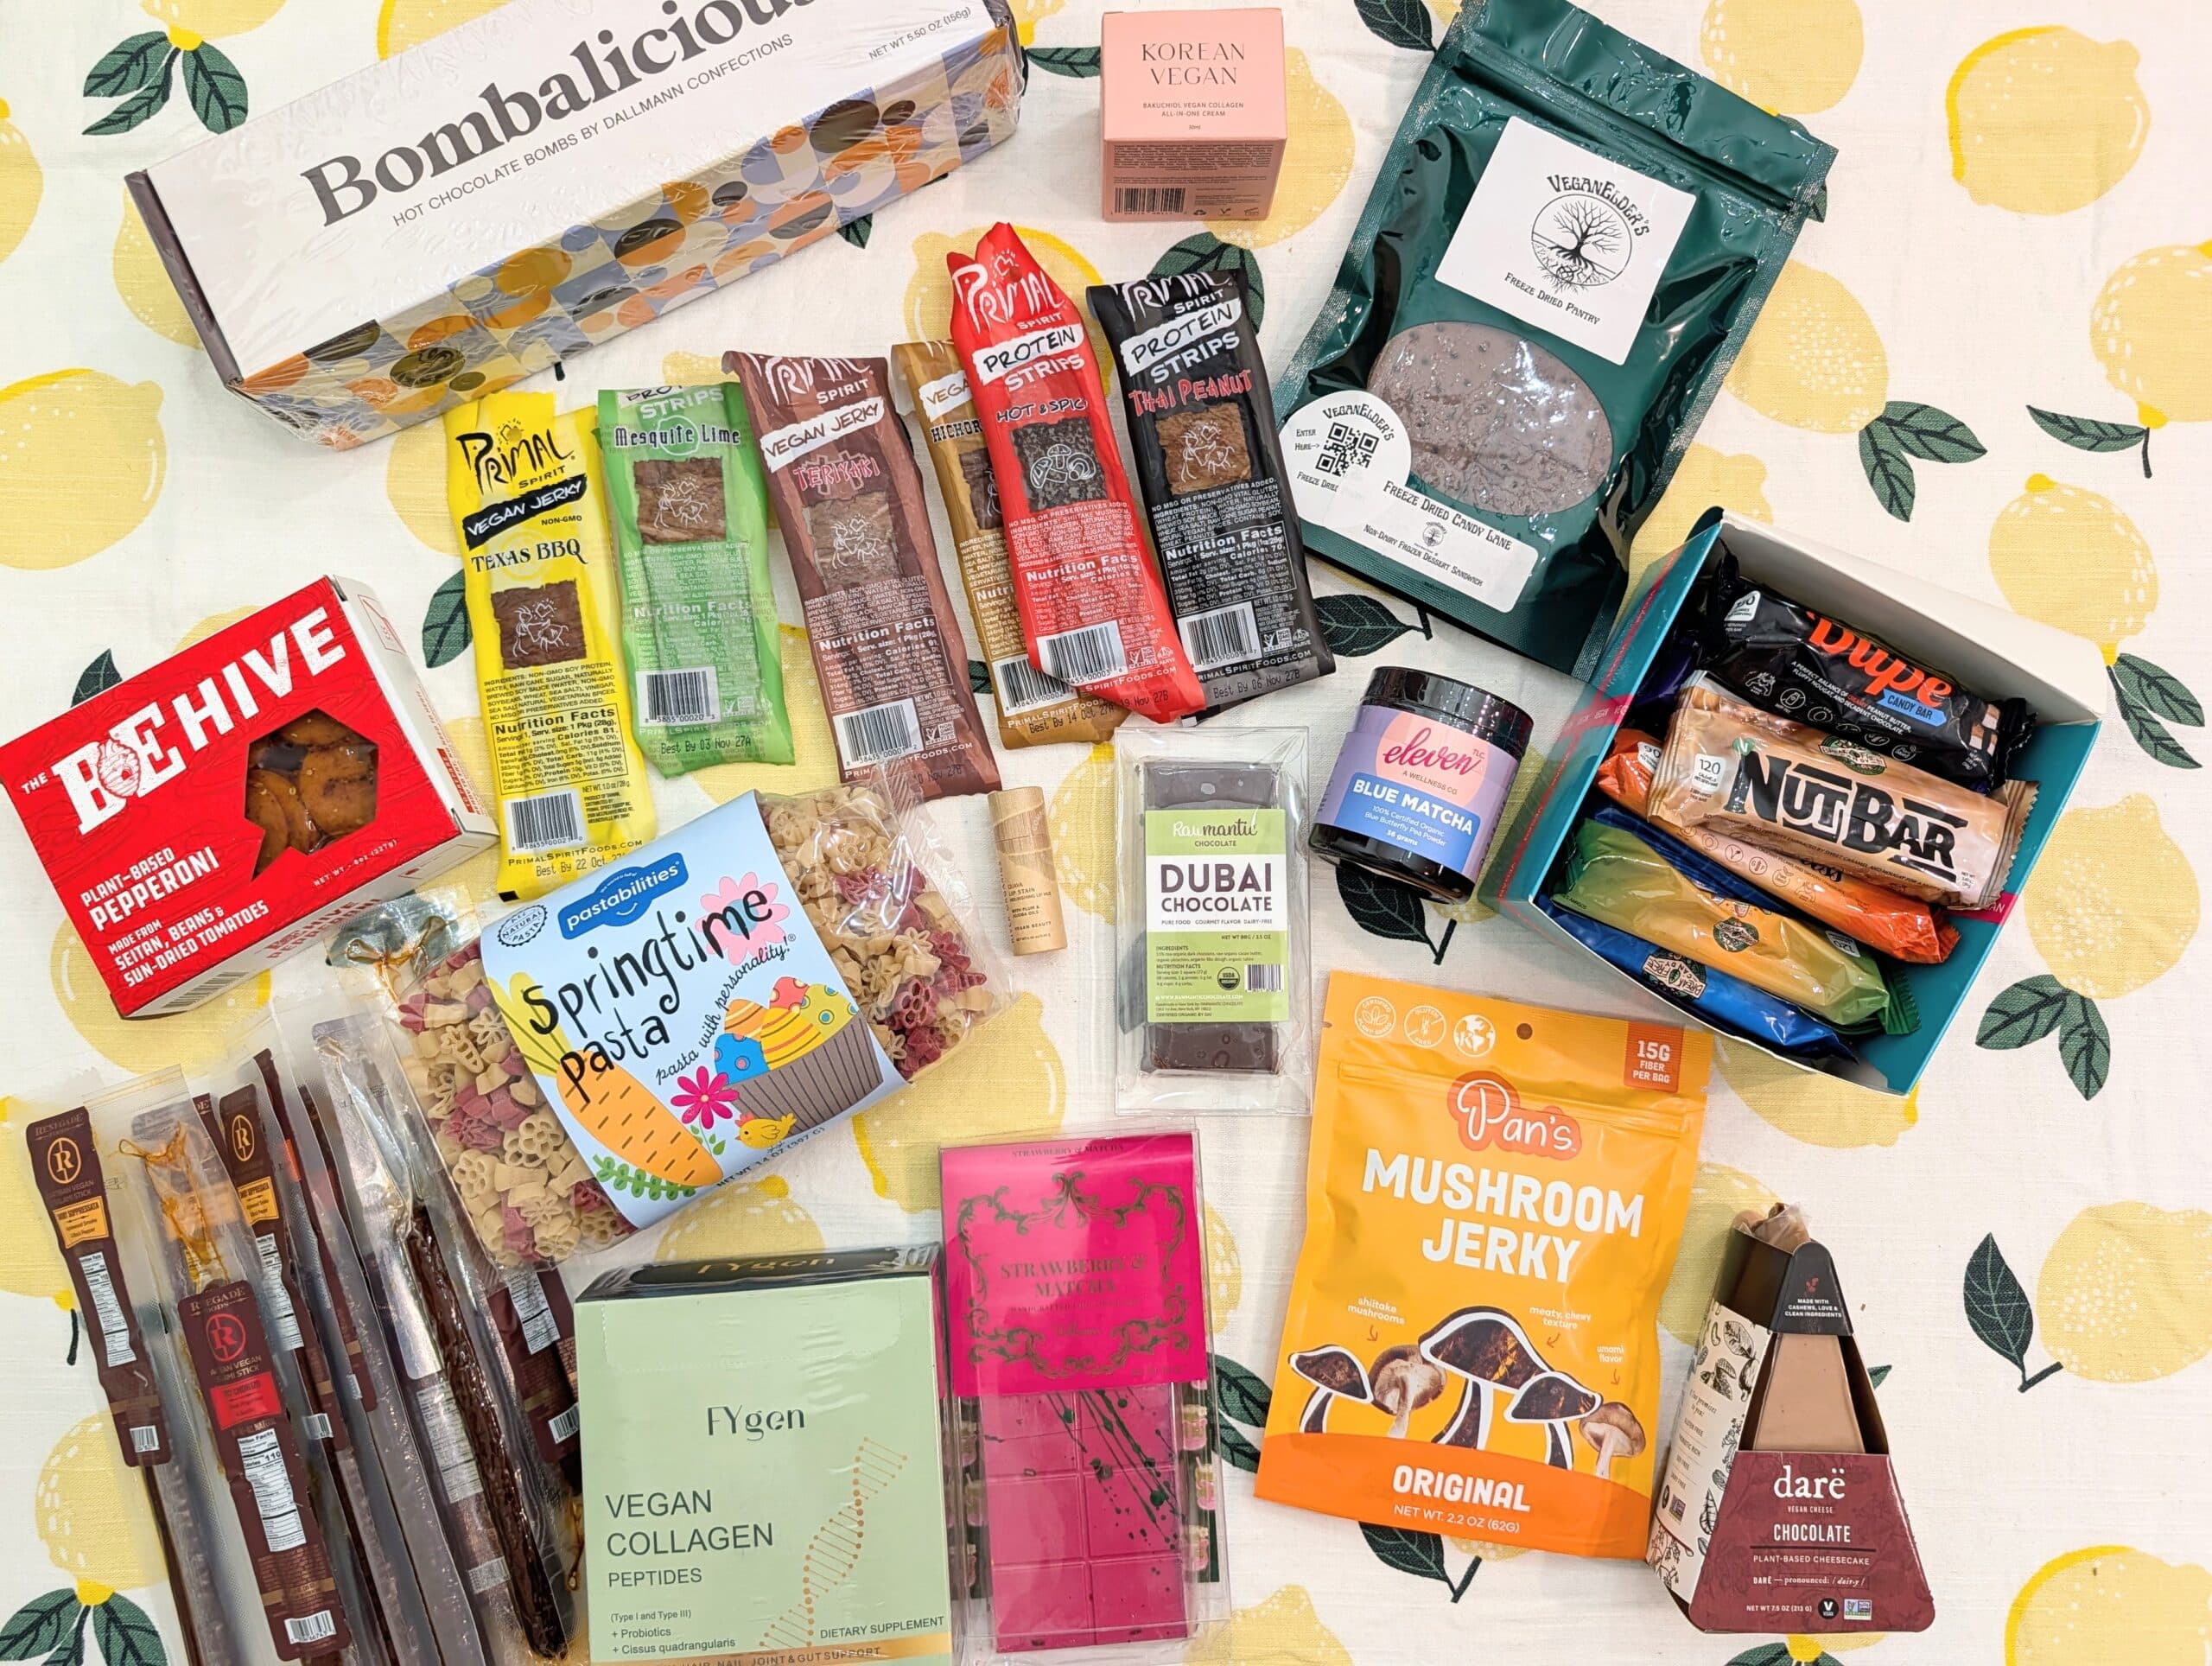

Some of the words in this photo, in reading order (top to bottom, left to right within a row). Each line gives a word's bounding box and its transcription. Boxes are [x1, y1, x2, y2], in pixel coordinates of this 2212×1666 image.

[868, 45, 887, 60] NET
[889, 37, 905, 48] WT
[907, 28, 926, 41] 5.50
[928, 20, 943, 31] OZ
[944, 7, 971, 25] (156g)
[1142, 43, 1245, 61] KOREAN
[1151, 67, 1236, 85] VEGAN
[301, 0, 815, 226] Bombaliciou
[392, 203, 425, 226] HOT
[429, 159, 522, 209] CHOCOLATE
[524, 133, 578, 166] BOMBS
[581, 123, 600, 140] BY
[603, 85, 684, 130] DALLMANN
[687, 34, 793, 90] CONFECTIONS
[1504, 272, 1535, 296] FREEZE
[1537, 289, 1563, 308] DRIED
[1566, 302, 1600, 325] PANTRY
[1131, 304, 1232, 364] PROTEIN
[983, 327, 1075, 373] PROTEIN
[1151, 332, 1240, 384] STRIPS
[1004, 354, 1084, 392] STRIPS
[640, 388, 724, 419] STRIPS
[817, 378, 868, 404] SPIRIT
[1128, 386, 1176, 416] THAI
[1179, 369, 1253, 405] PEANUT
[996, 403, 1034, 422] HOT
[615, 424, 693, 449] Mesquite
[702, 424, 740, 444] Lime
[766, 423, 824, 457] VEGAN
[831, 404, 878, 432] JERKY
[518, 466, 566, 488] SPIRIT
[793, 457, 880, 491] TERIYAKI
[467, 503, 525, 536] VEGAN
[531, 481, 582, 509] JERKY
[1383, 481, 1418, 506] FREEZE
[1421, 499, 1450, 521] DRIED
[1452, 516, 1485, 537] CANDY
[1486, 529, 1512, 551] LANE
[472, 548, 531, 572] TEXAS
[537, 538, 588, 564] BBQ
[1166, 536, 1236, 561] Nutrition
[1241, 525, 1282, 541] Facts
[1363, 524, 1398, 546] NON-DAIRY
[1399, 541, 1422, 556] FROZEN
[1423, 552, 1450, 570] DESSERT
[1797, 663, 1818, 679] PERFECT
[1818, 675, 1840, 694] BALANCE
[1867, 705, 1889, 719] PEANUT
[1887, 695, 1914, 713] CANDY
[1916, 706, 1932, 720] BAR
[1382, 728, 1481, 775] eleven
[1699, 759, 1721, 775] 120
[22, 772, 48, 795] THE
[1409, 773, 1446, 791] WELLNESS
[1353, 779, 1399, 804] BLUE
[1402, 794, 1472, 836] MATCHA
[1373, 805, 1389, 816] 100%
[1391, 811, 1419, 827] Certified
[1421, 822, 1445, 836] Organic
[1364, 812, 1378, 821] Blue
[1380, 817, 1408, 832] Butterfly
[1409, 826, 1422, 836] Pea
[1423, 831, 1446, 846] Powder
[1396, 833, 1419, 846] grams
[80, 847, 175, 906] PLANT-BASED
[537, 866, 556, 877] Best
[562, 862, 571, 873] By
[575, 859, 586, 870] 22
[1161, 862, 1271, 893] DUBAI
[90, 846, 219, 932] PEPPERONI
[567, 864, 678, 931] pastabilities
[1161, 897, 1272, 912] CHOCOLATE
[108, 933, 135, 955] MADE
[137, 919, 162, 942] FROM
[114, 936, 169, 970] SEITAN,
[168, 911, 215, 943] BEANS
[124, 937, 199, 988] SUN-DRIED
[200, 900, 269, 946] TOMATOES
[523, 889, 773, 1038] Springtime
[656, 1050, 699, 1085] pasta
[699, 1014, 721, 1047] with
[716, 935, 791, 1011] personality!
[561, 1007, 671, 1103] pasta
[1637, 1040, 1670, 1061] 15G
[1640, 1060, 1664, 1071] FIBER
[1632, 1070, 1650, 1080] PER
[1652, 1072, 1670, 1084] BAG
[1457, 1078, 1573, 1151] Pan's
[1362, 1148, 1644, 1238] MUSHROOM
[1421, 1218, 1580, 1283] JERKY
[1001, 1257, 1123, 1279] STRAWBERRY
[1035, 1279, 1116, 1297] MATCHA
[1347, 1304, 1405, 1325] mushrooms
[1357, 1297, 1397, 1313] shiitake
[1565, 1311, 1591, 1323] chewy
[1543, 1318, 1578, 1330] texture
[232, 1355, 262, 1368] VEGAN
[1597, 1344, 1624, 1354] umami
[1599, 1353, 1623, 1363] flavor
[236, 1365, 260, 1377] STICK
[708, 1405, 805, 1441] FYgen
[264, 1451, 281, 1462] 110
[1393, 1465, 1530, 1511] ORIGINAL
[1774, 1465, 1845, 1499] darë
[606, 1490, 712, 1518] VEGAN
[1394, 1504, 1420, 1517] NET
[1446, 1514, 1465, 1524] 2.2
[1466, 1517, 1484, 1528] OZ
[1488, 1518, 1520, 1534] (62G)
[607, 1523, 773, 1556] COLLAGEN
[1774, 1524, 1851, 1542] CHOCOLATE
[1814, 1556, 1870, 1565] CHEESECAKE
[609, 1567, 702, 1587] PEPTIDES
[611, 1612, 634, 1623] (Type
[658, 1610, 678, 1621] Type
[680, 1609, 691, 1619] III)
[820, 1625, 867, 1638] DIETARY
[870, 1616, 944, 1634] SUPPLEMENT
[621, 1626, 671, 1638] Probiotics
[622, 1644, 656, 1655] Cissus
[658, 1638, 735, 1653] quadrangularis
